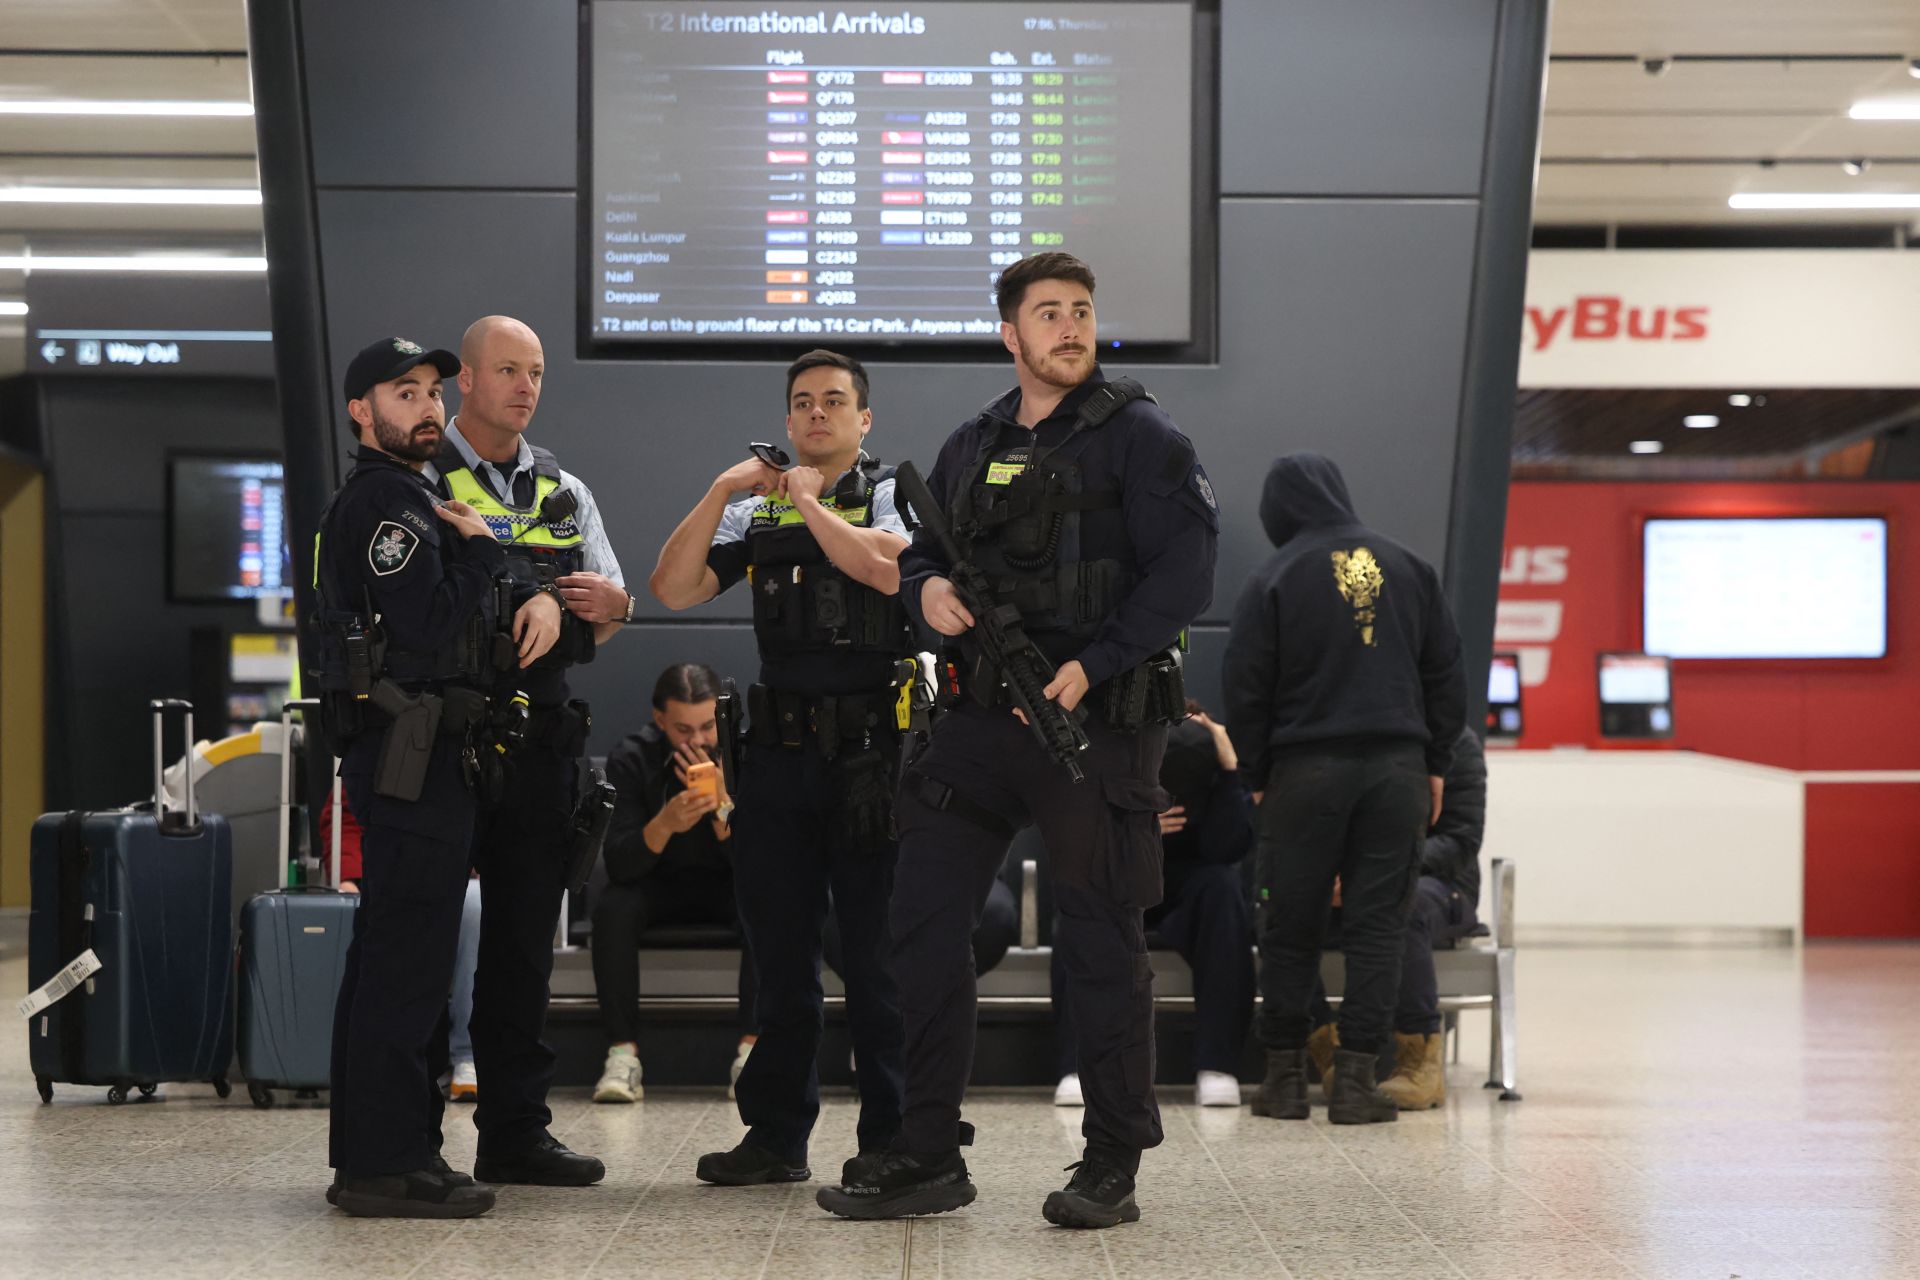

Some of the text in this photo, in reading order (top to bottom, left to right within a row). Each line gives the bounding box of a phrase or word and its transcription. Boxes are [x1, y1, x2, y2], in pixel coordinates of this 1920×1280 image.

[680, 11, 827, 34] International
[832, 11, 926, 34] Arrivals
[766, 50, 805, 65] Flight
[606, 211, 637, 223] Delhi
[605, 231, 639, 243] Kuala
[641, 231, 686, 244] Lumpur
[605, 250, 669, 264] Guangzhou
[605, 270, 634, 282] Nadi
[605, 290, 660, 304] Denpasar
[602, 317, 621, 332] T2
[623, 317, 649, 332] and
[651, 319, 668, 332] on
[670, 317, 694, 332] the
[695, 317, 744, 334] ground
[745, 317, 778, 332] floor
[779, 317, 798, 333] of
[799, 317, 822, 333] the
[823, 318, 844, 333] T4
[845, 318, 871, 333] Car
[872, 318, 909, 333] Park.
[911, 318, 962, 335] Anyone
[963, 318, 994, 333] who
[1524, 296, 1709, 352] yBus
[105, 341, 180, 365] Way Out
